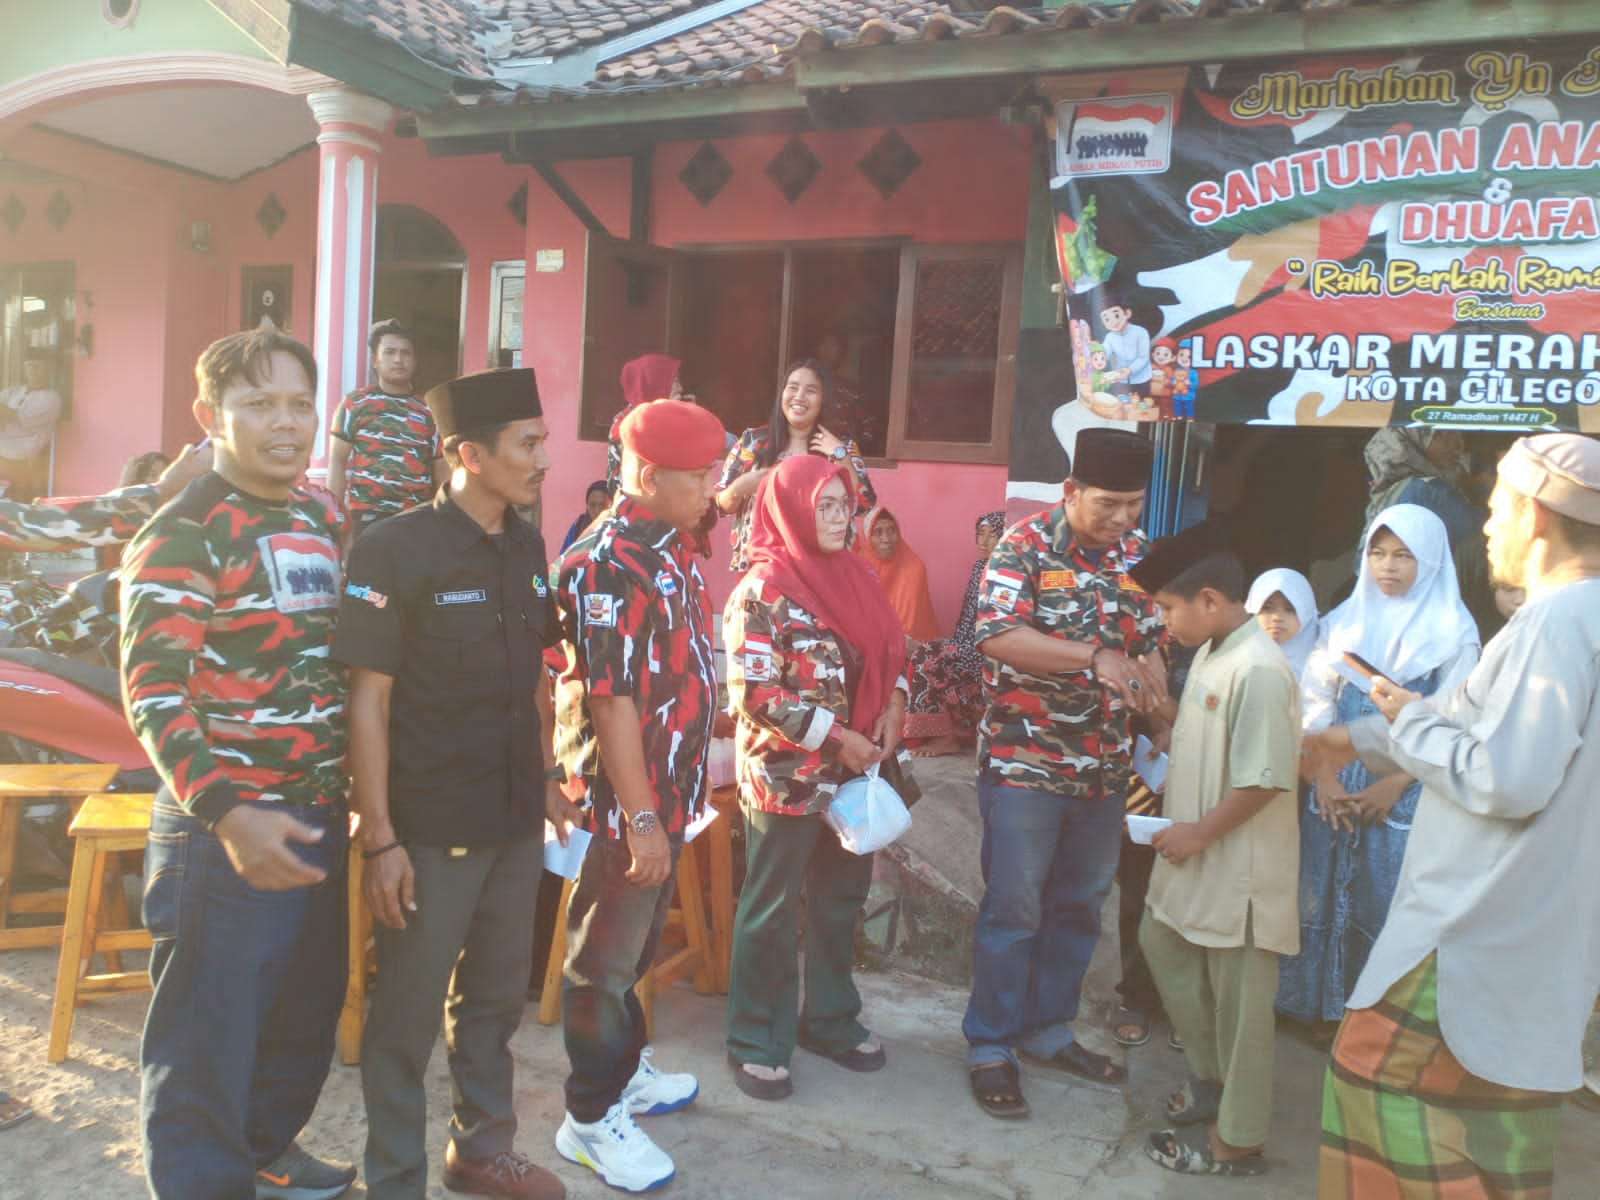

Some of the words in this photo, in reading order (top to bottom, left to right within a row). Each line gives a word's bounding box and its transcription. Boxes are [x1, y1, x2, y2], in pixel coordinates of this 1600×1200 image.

[1232, 65, 1457, 117] Marhaban
[1467, 53, 1550, 111] Ya
[1187, 127, 1479, 226] SANTUNAN
[1484, 177, 1513, 204] &
[1400, 197, 1600, 244] DHUAFA
[1312, 260, 1383, 298] Raih
[1385, 258, 1512, 297] Berkah
[1454, 297, 1545, 321] Bersama
[1191, 334, 1392, 369] LASKAR
[1346, 375, 1448, 403] KOTA
[1426, 411, 1441, 421] 27
[1442, 411, 1500, 423] Ramadhan
[1502, 412, 1528, 423] 1447
